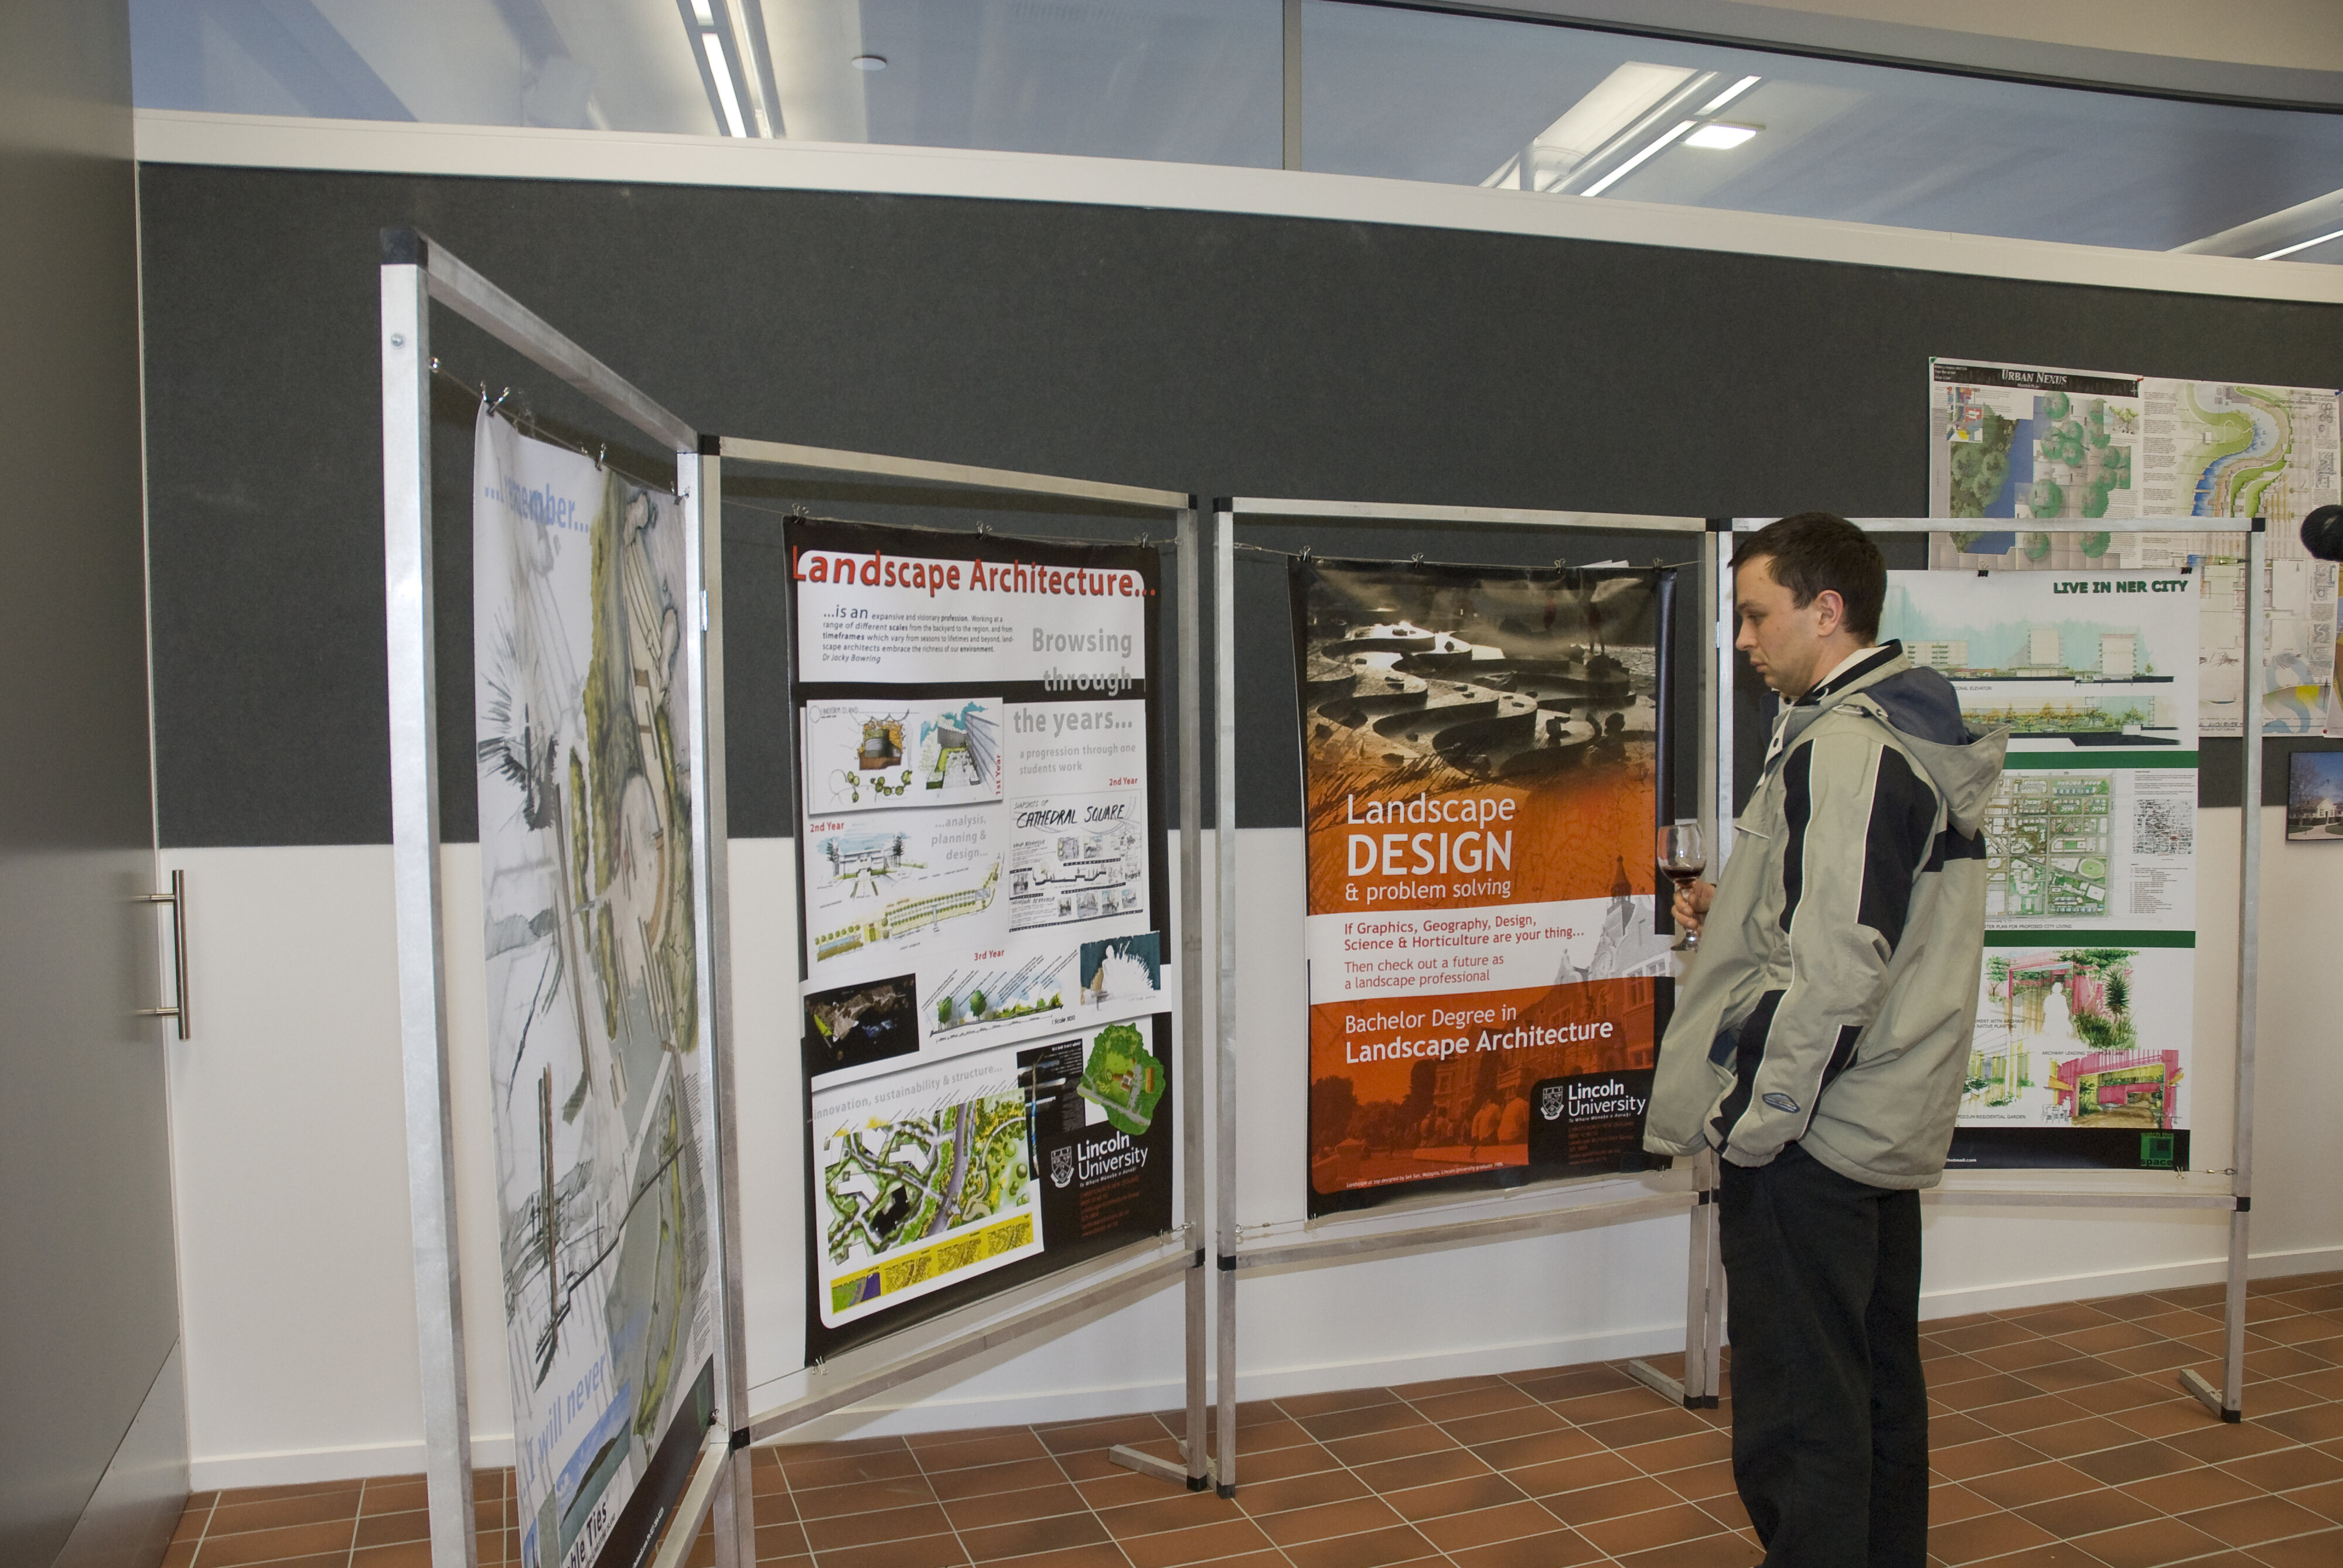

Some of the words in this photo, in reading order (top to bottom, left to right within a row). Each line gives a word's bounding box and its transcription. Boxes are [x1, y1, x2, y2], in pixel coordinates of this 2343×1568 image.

[2001, 370, 2034, 382] URBAN
[2035, 372, 2068, 385] NEXUS
[793, 545, 961, 597] Landscape
[970, 558, 1156, 598] Architecture...
[2053, 581, 2089, 594] LIVE
[2092, 580, 2110, 593] IN
[2116, 580, 2147, 593] NER
[2151, 580, 2188, 593] CITY
[823, 604, 847, 618] ...is
[850, 608, 868, 619] an
[918, 614, 940, 623] visionary
[971, 615, 993, 624] Working
[823, 631, 864, 640] timeframes
[947, 634, 968, 643] lifetimes
[855, 622, 887, 630] different
[1032, 627, 1133, 658] Browsing
[823, 653, 830, 661] Dr
[831, 654, 850, 663] Jacky
[851, 654, 881, 664] Bowring
[1043, 666, 1133, 696] through
[1014, 708, 1046, 733] the
[1053, 709, 1133, 738] years...
[1026, 746, 1079, 761] progression
[1082, 743, 1118, 760] through
[1119, 744, 1137, 754] one
[1019, 763, 1056, 775] students
[1059, 761, 1083, 772] work
[1109, 778, 1121, 787] 2nd
[1123, 776, 1138, 786] Year
[1017, 809, 1077, 829] CATHEDRAL
[1084, 804, 1125, 822] SQUARE
[1347, 792, 1516, 829] Landscape
[810, 822, 826, 832] 2nd
[826, 821, 844, 831] Year
[935, 815, 987, 829] ...analysis,
[932, 831, 977, 846] planning
[978, 831, 987, 840] &
[946, 847, 988, 860] design...
[1348, 830, 1512, 877] DESIGN
[1345, 884, 1359, 901] &
[1366, 882, 1447, 904] problem
[1452, 878, 1511, 899] solving
[1345, 922, 1353, 934] If
[1357, 919, 1418, 936] Graphics,
[1423, 916, 1491, 934] Geography,
[1495, 914, 1537, 930] Design,
[1345, 937, 1394, 951] Science
[1398, 937, 1408, 948] &
[1412, 932, 1489, 948] Horticulture
[1493, 933, 1512, 944] are
[1516, 931, 1541, 945] your
[1544, 925, 1584, 942] thing...
[974, 951, 987, 961] 3rd
[988, 949, 1005, 959] Year
[1345, 959, 1374, 973] Then
[1377, 957, 1414, 971] check
[1417, 958, 1438, 970] out
[1441, 959, 1448, 968] a
[1452, 954, 1489, 968] future
[1492, 955, 1504, 966] as
[1345, 980, 1351, 989] a
[1355, 973, 1416, 991] landscape
[1419, 969, 1491, 988] professional
[1346, 1010, 1425, 1034] Bachelor
[1432, 1007, 1495, 1030] Degree
[1502, 1005, 1517, 1021] in
[1346, 1035, 1469, 1064] Landscape
[1475, 1018, 1614, 1052] Architecture
[875, 1077, 940, 1104] sustainability
[943, 1075, 950, 1085] &
[951, 1065, 1002, 1084] structure...
[1568, 1079, 1624, 1100] Lincoln
[1568, 1095, 1646, 1116] University
[1077, 1131, 1130, 1162] Lincoln
[1079, 1147, 1148, 1180] University
[538, 1395, 562, 1464] will
[567, 1351, 606, 1424] never
[586, 1502, 607, 1547] Ties
